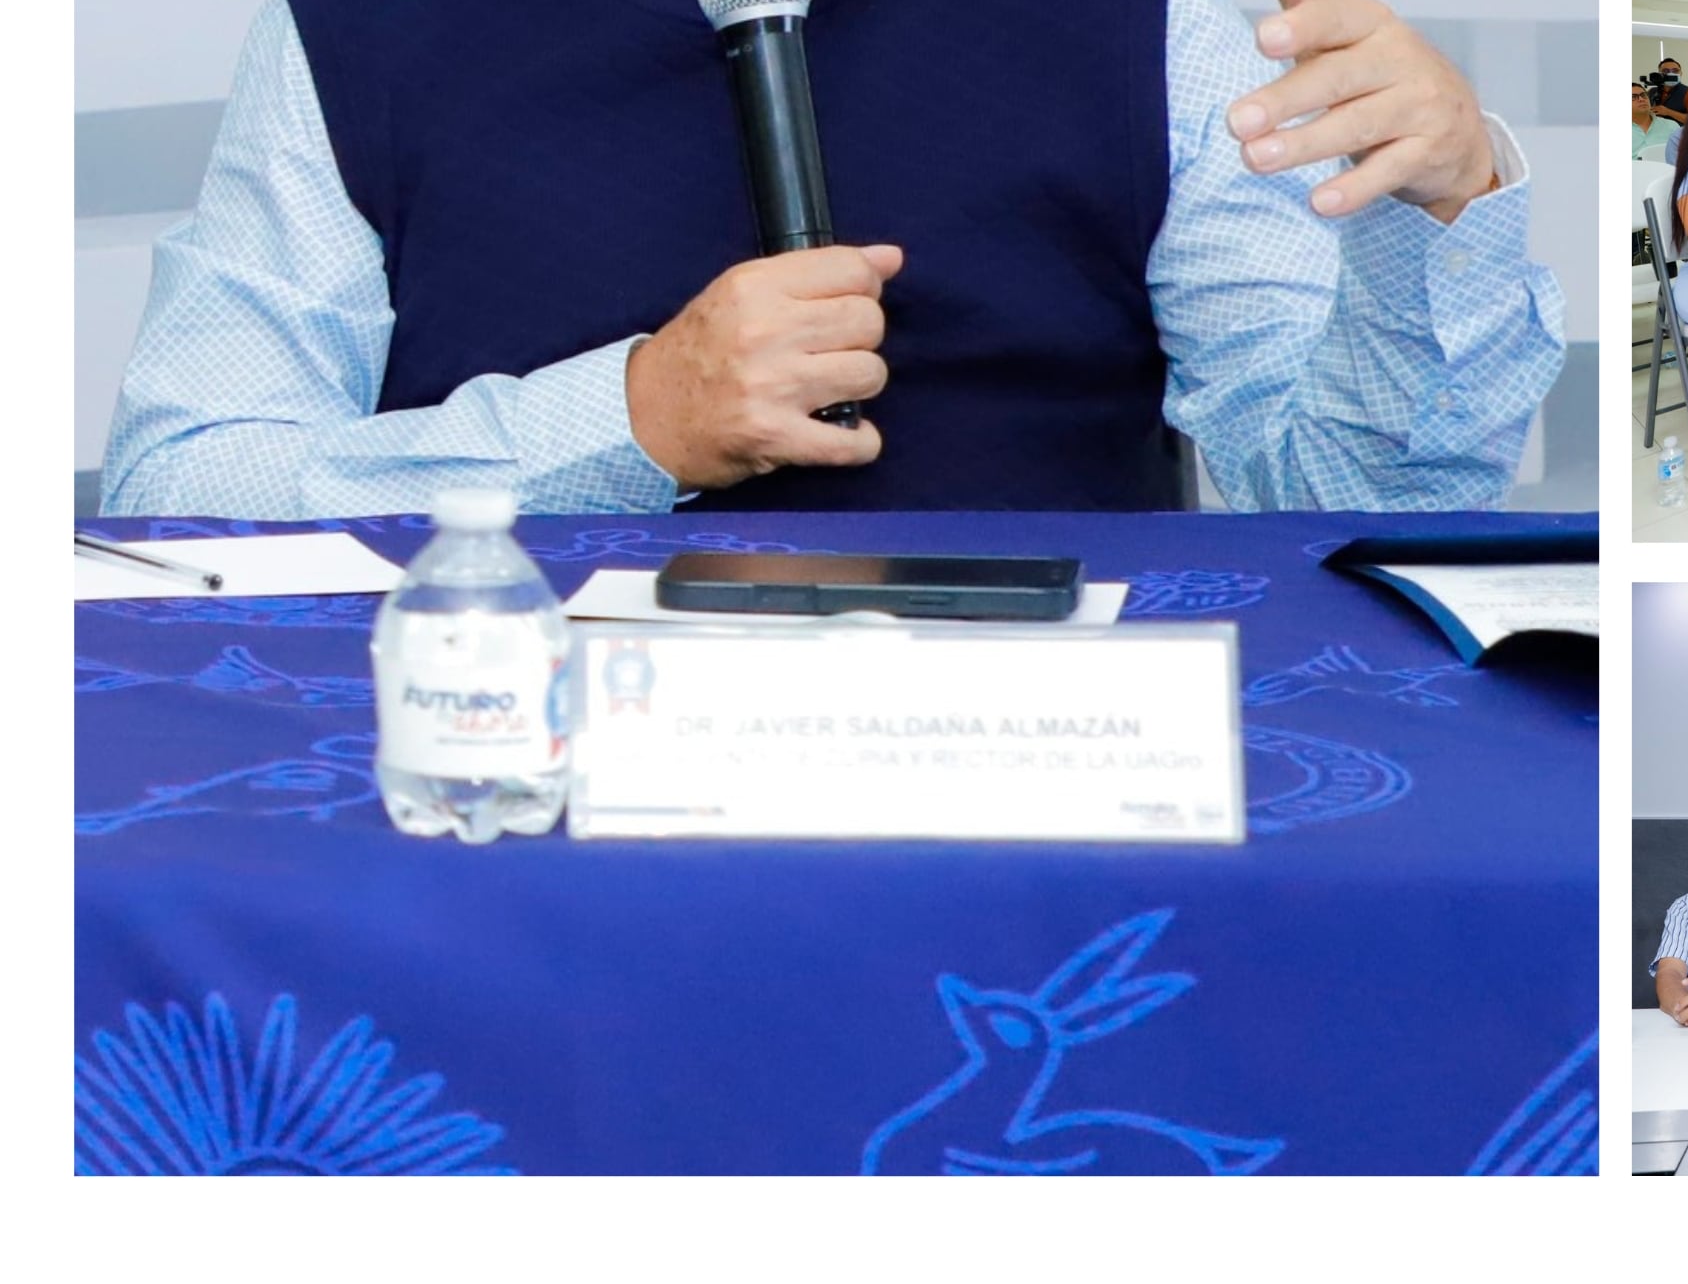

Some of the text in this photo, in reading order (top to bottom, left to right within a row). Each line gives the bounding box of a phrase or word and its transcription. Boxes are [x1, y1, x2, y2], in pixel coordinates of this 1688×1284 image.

[733, 716, 836, 737] JAVIER
[845, 711, 987, 738] SALDAÑA
[997, 711, 1142, 738] ALMAZÁN
[1045, 750, 1078, 769] DE
[1086, 750, 1116, 769] LA
